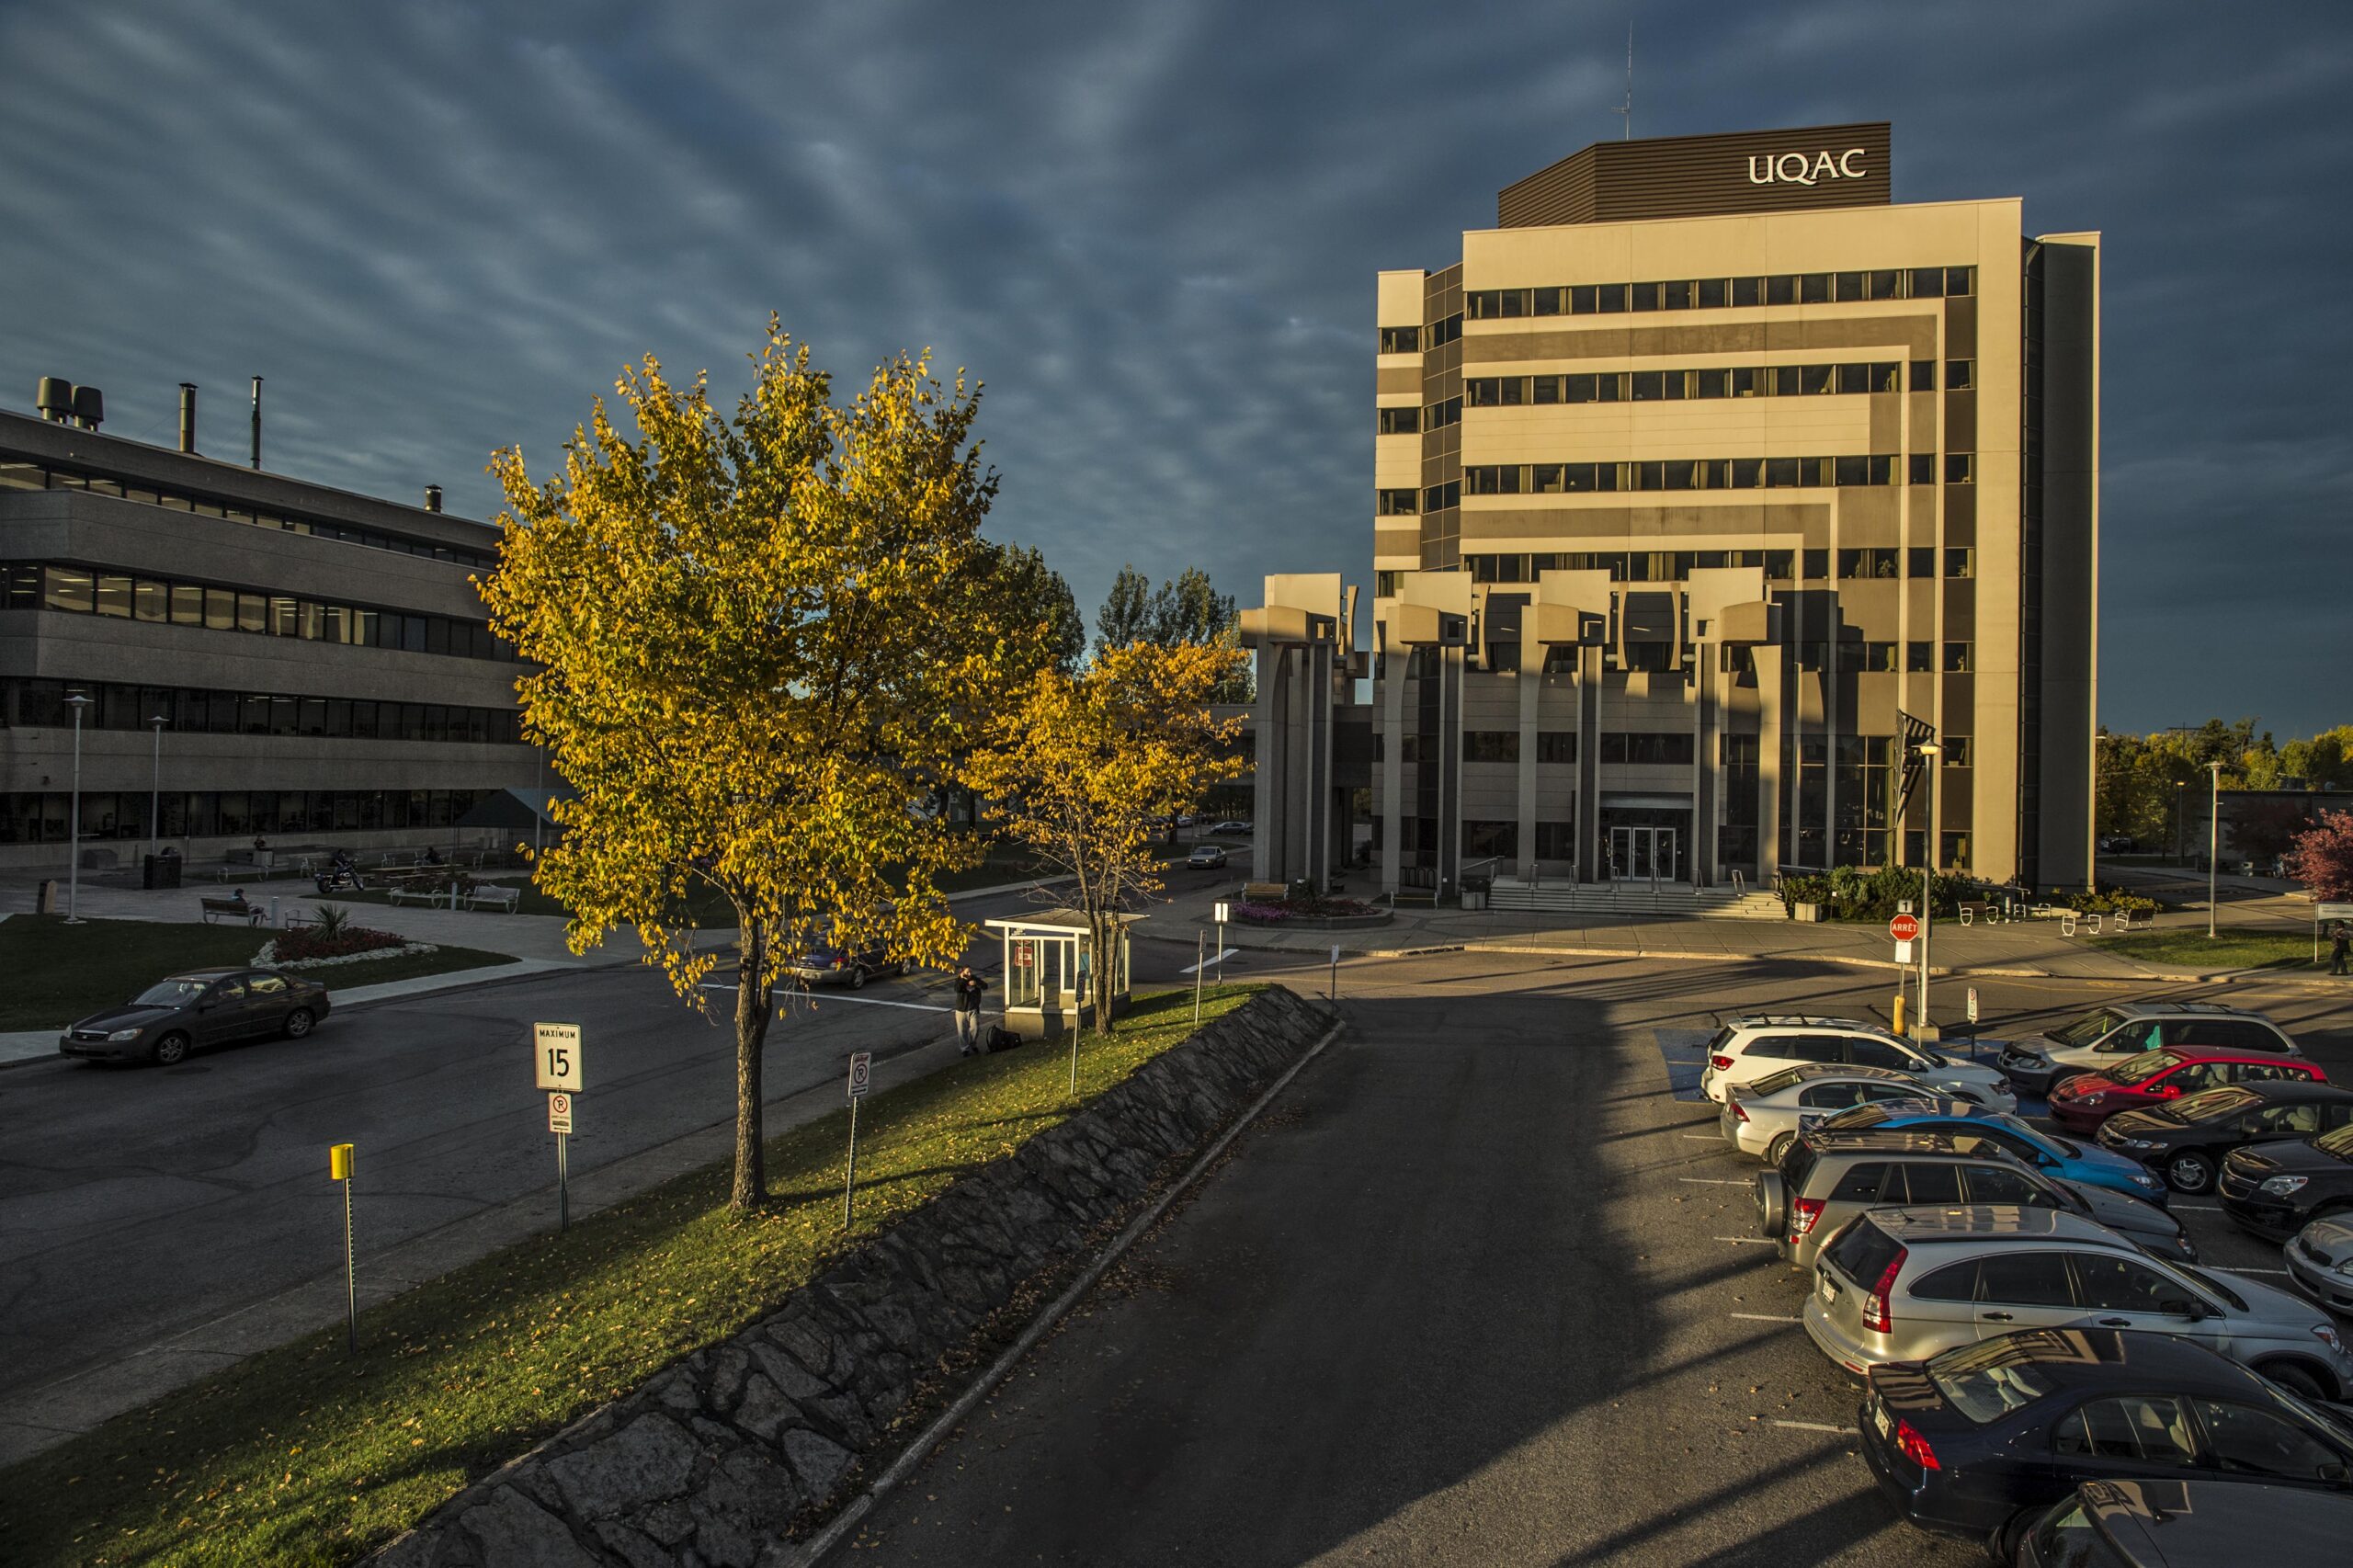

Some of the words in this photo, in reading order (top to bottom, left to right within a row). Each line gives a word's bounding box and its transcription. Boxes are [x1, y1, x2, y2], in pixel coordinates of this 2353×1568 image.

[1748, 148, 1867, 186] UQAC
[1903, 902, 1908, 912] 1
[1892, 923, 1917, 932] ARRÊT
[540, 1029, 575, 1039] MAXIMUM
[548, 1048, 569, 1076] 15
